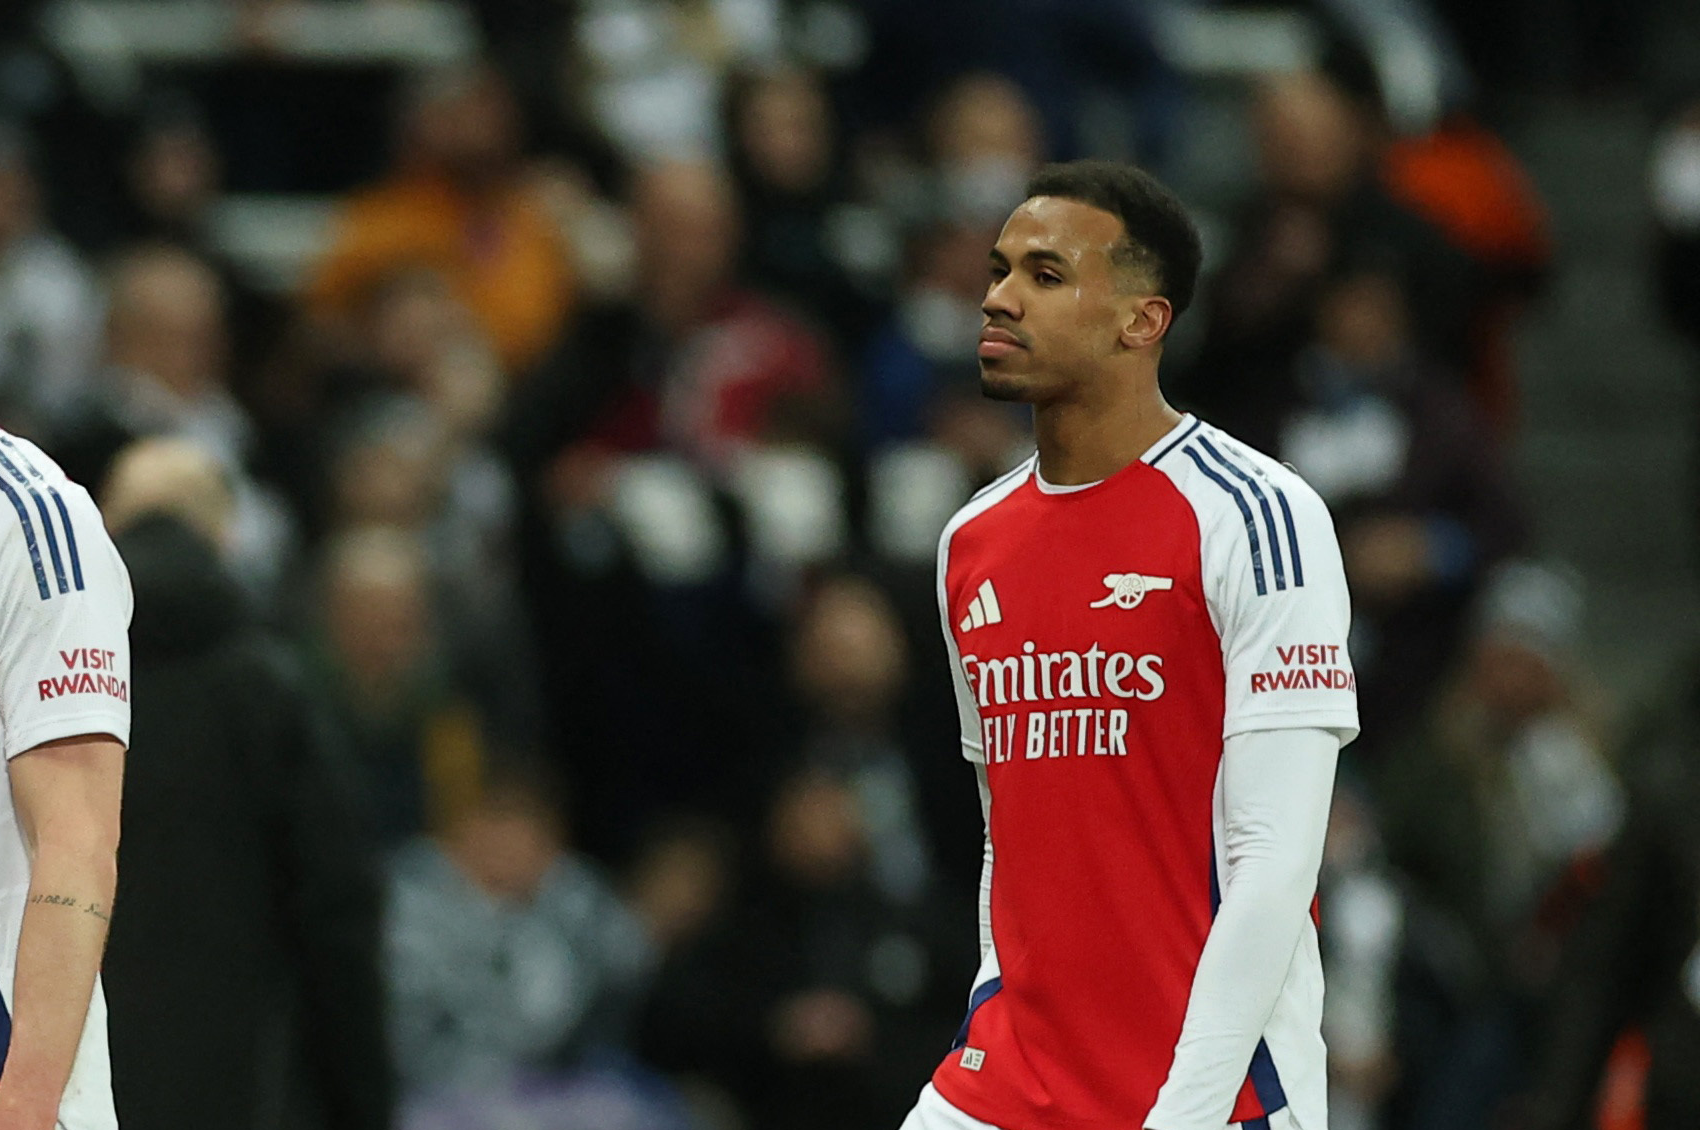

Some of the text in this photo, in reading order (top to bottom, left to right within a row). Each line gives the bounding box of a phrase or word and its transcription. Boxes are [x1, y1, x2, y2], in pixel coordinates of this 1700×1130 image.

[59, 648, 115, 671] VISIT
[1276, 644, 1339, 665] VISIT
[38, 672, 127, 703] RWANDA
[983, 708, 1128, 765] FLY BETTER
